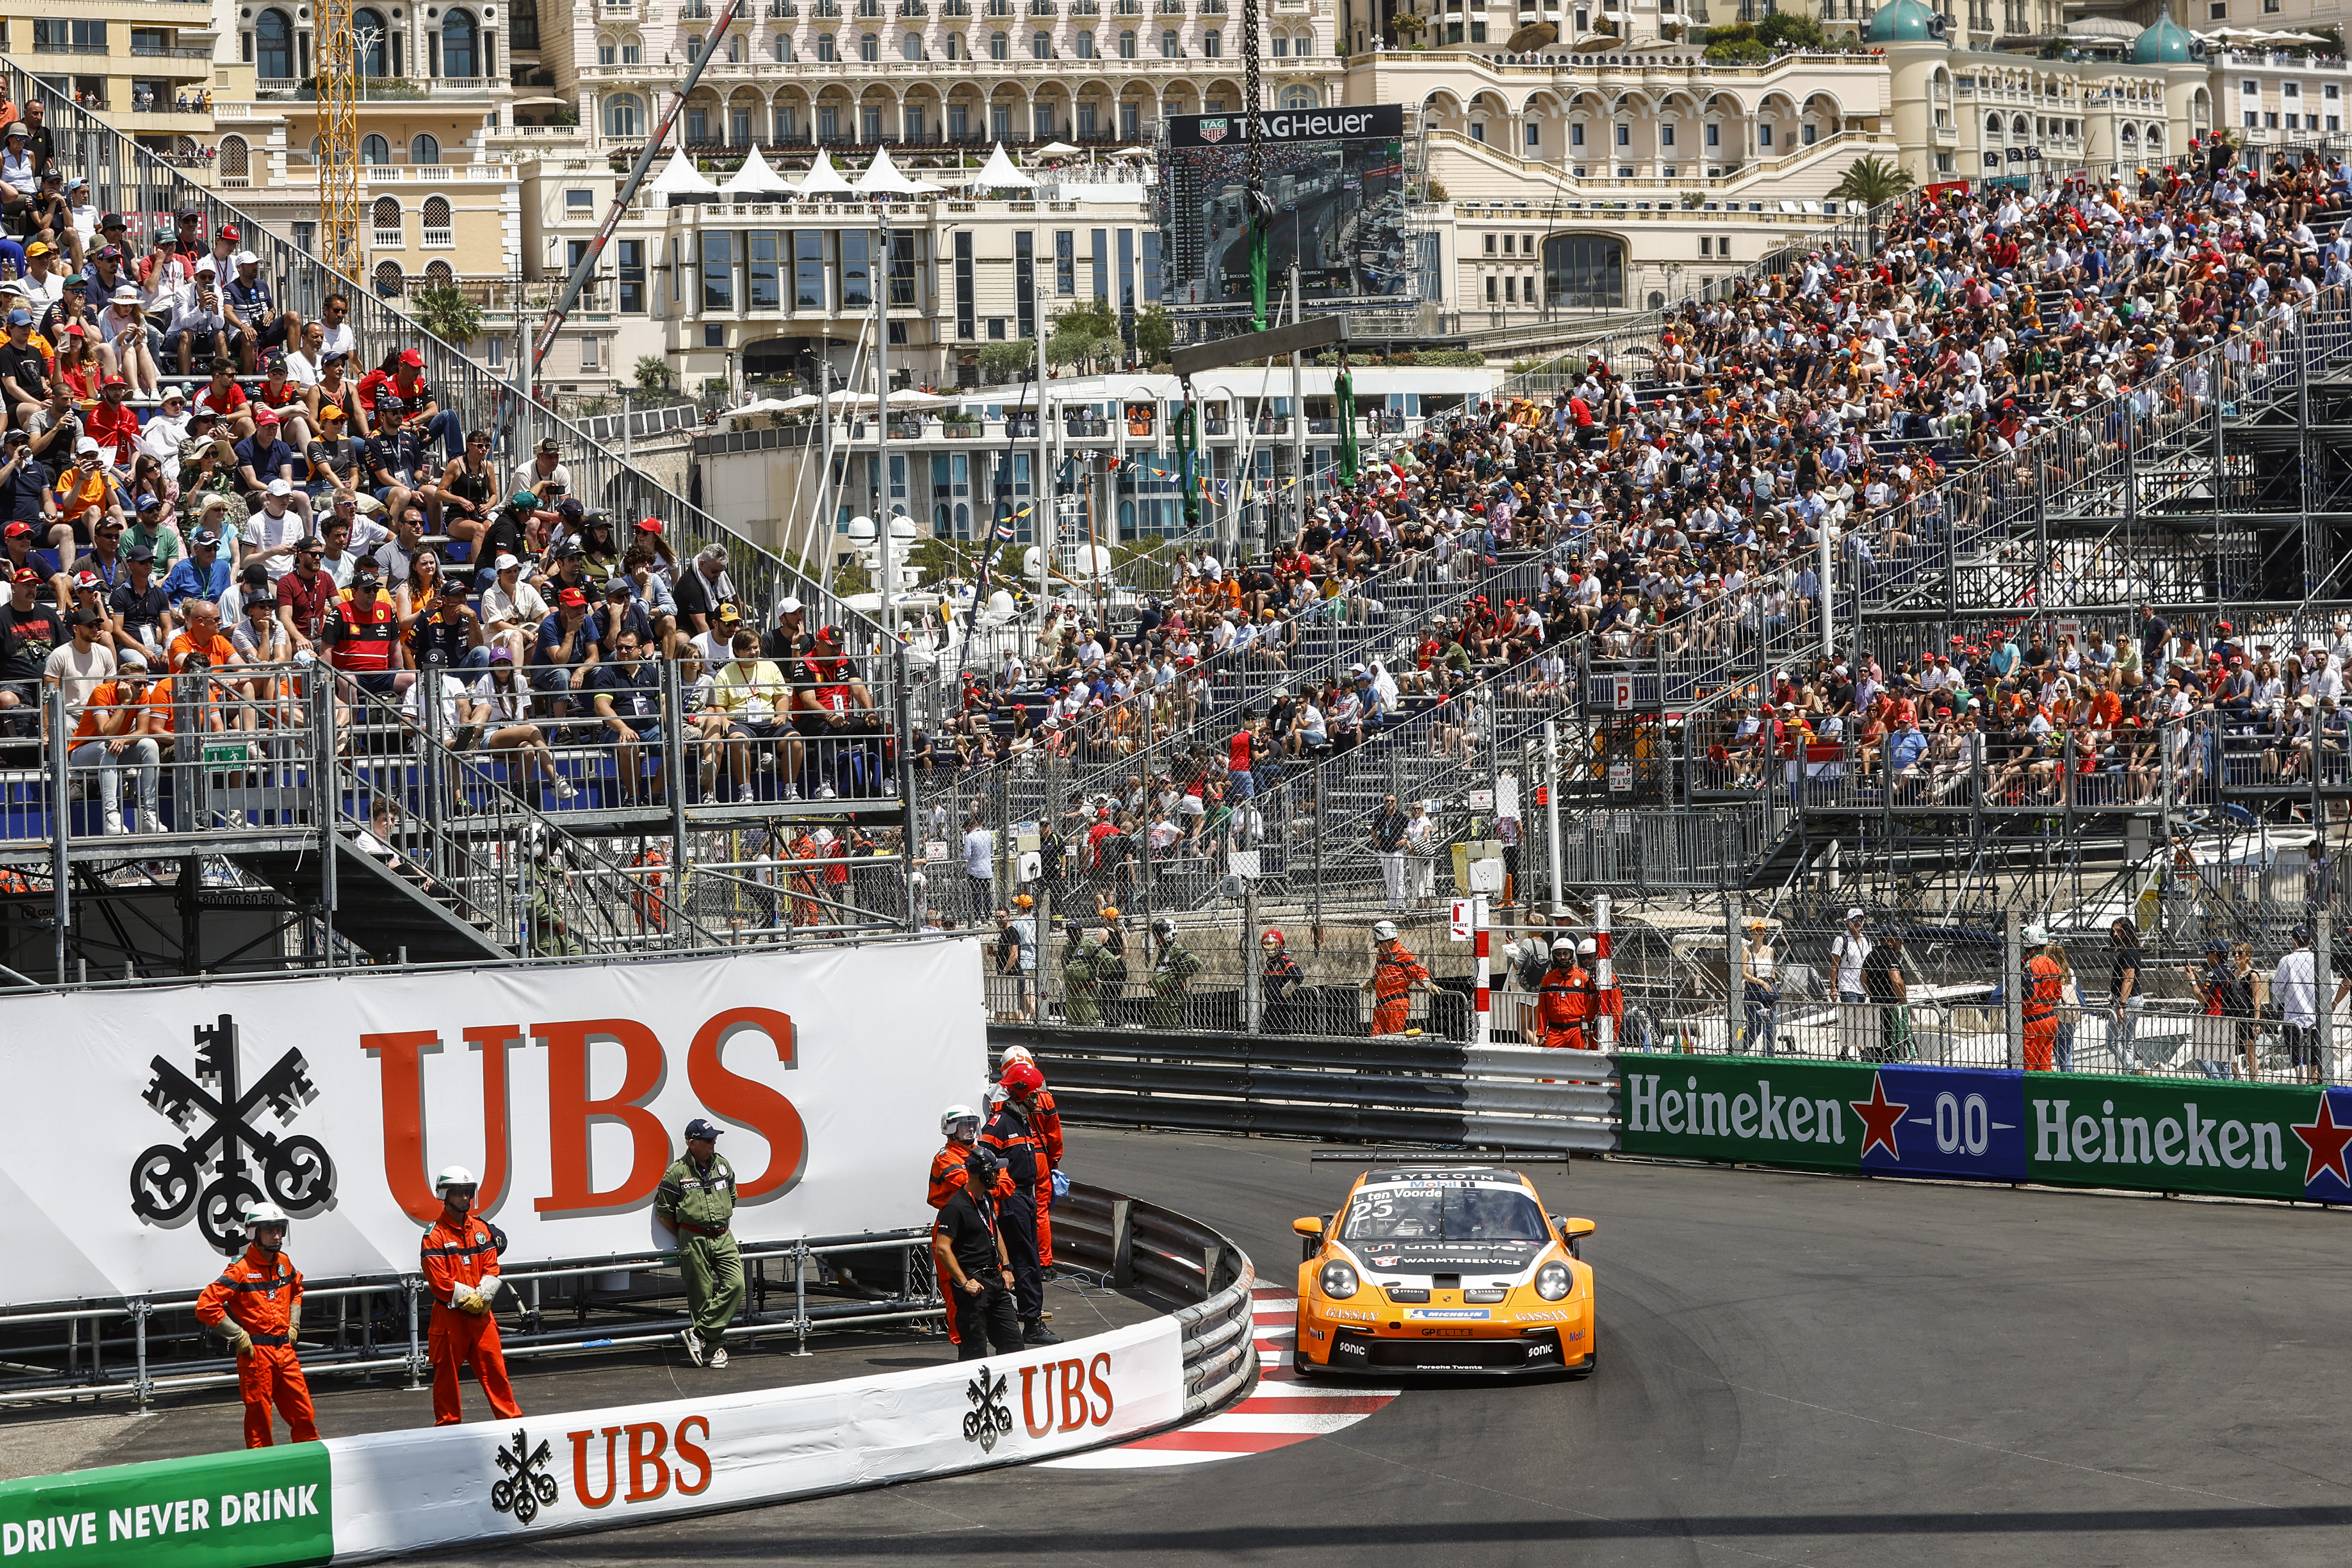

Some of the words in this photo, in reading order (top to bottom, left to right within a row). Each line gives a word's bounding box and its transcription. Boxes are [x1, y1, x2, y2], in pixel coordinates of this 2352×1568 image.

[1201, 120, 1225, 128] TAG
[1200, 129, 1226, 142] HEUER
[539, 332, 553, 351] IMPERIAL
[550, 317, 561, 333] LEVAGE
[1618, 686, 1629, 706] P
[1226, 881, 1235, 891] 21
[360, 1006, 808, 1227] UBS
[1628, 1073, 1846, 1144] Heineken
[1935, 1091, 1989, 1156] 0.0
[2032, 1098, 2287, 1171] Heineken
[1353, 1195, 1364, 1205] L.
[1368, 1190, 1390, 1201] ten
[1394, 1188, 1443, 1199] Voorde
[1351, 1199, 1394, 1223] 25
[1404, 1244, 1528, 1253] uniserver
[463, 1255, 470, 1265] 15
[268, 1290, 275, 1299] 15
[1325, 1307, 1381, 1322] GASSAN
[1515, 1310, 1569, 1322] GASSAN
[1019, 1352, 1114, 1440] UBS
[567, 1415, 712, 1510] UBS
[2, 1512, 97, 1557] DRIVE
[109, 1498, 211, 1542] NEVER
[221, 1483, 320, 1527] DRINK
